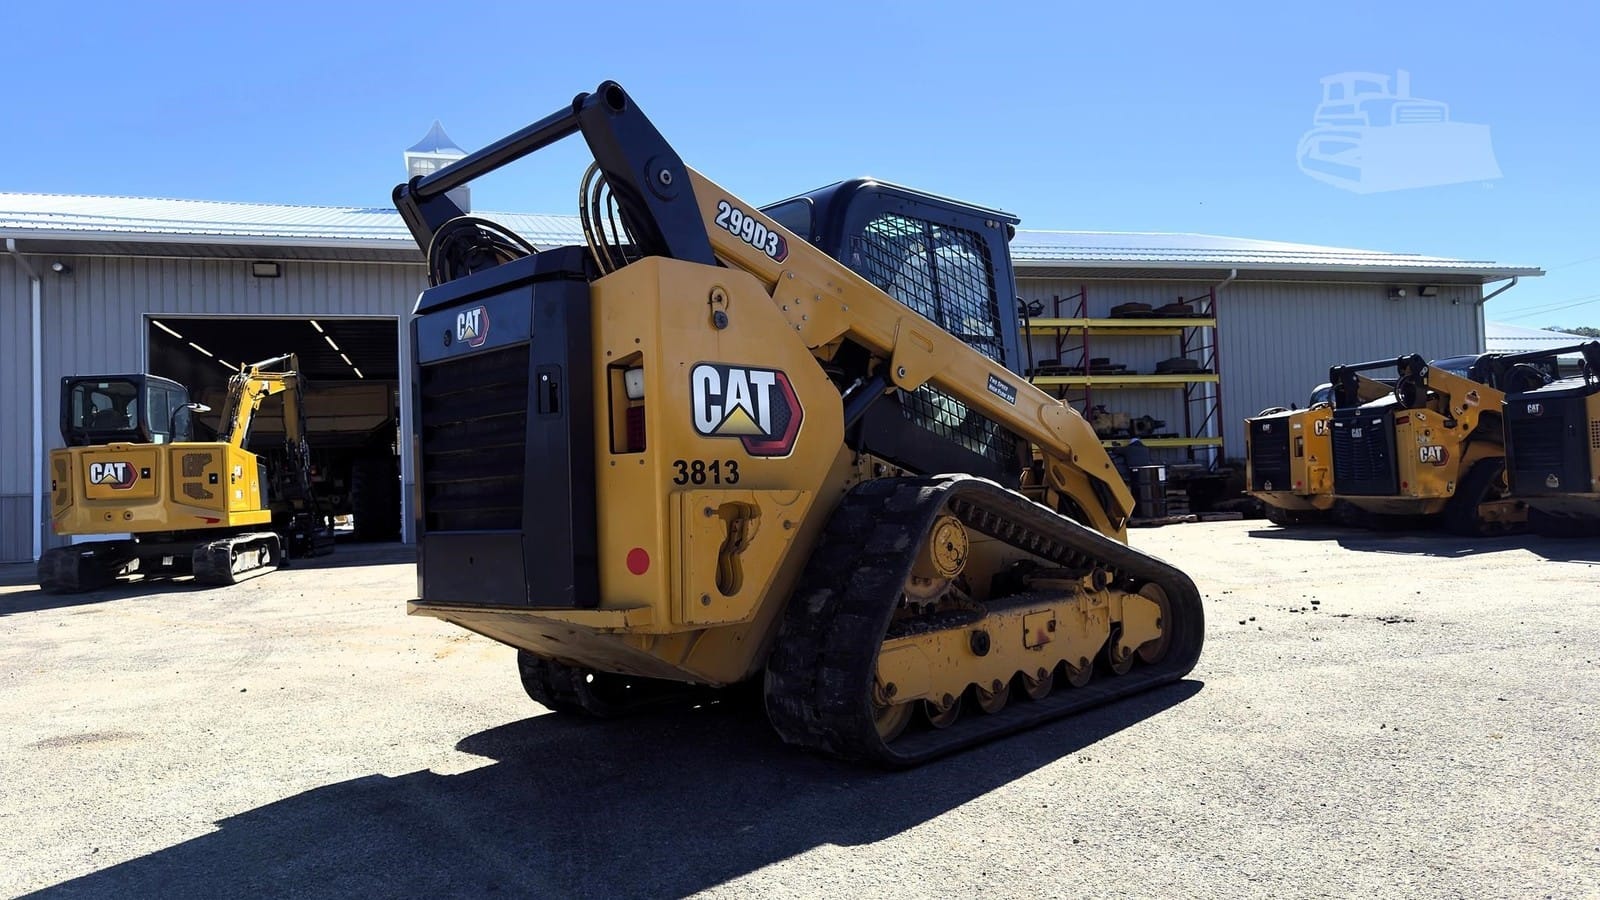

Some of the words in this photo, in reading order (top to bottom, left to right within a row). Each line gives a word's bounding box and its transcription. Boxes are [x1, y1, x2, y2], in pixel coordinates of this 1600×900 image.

[715, 200, 780, 259] 299D3
[456, 308, 481, 341] CAT
[692, 365, 776, 436] CAT
[1527, 403, 1540, 414] CAT
[1315, 420, 1330, 435] CA
[1351, 428, 1362, 438] CAT
[1419, 446, 1443, 463] CAT
[90, 462, 127, 484] CAT
[672, 460, 740, 485] 3813
